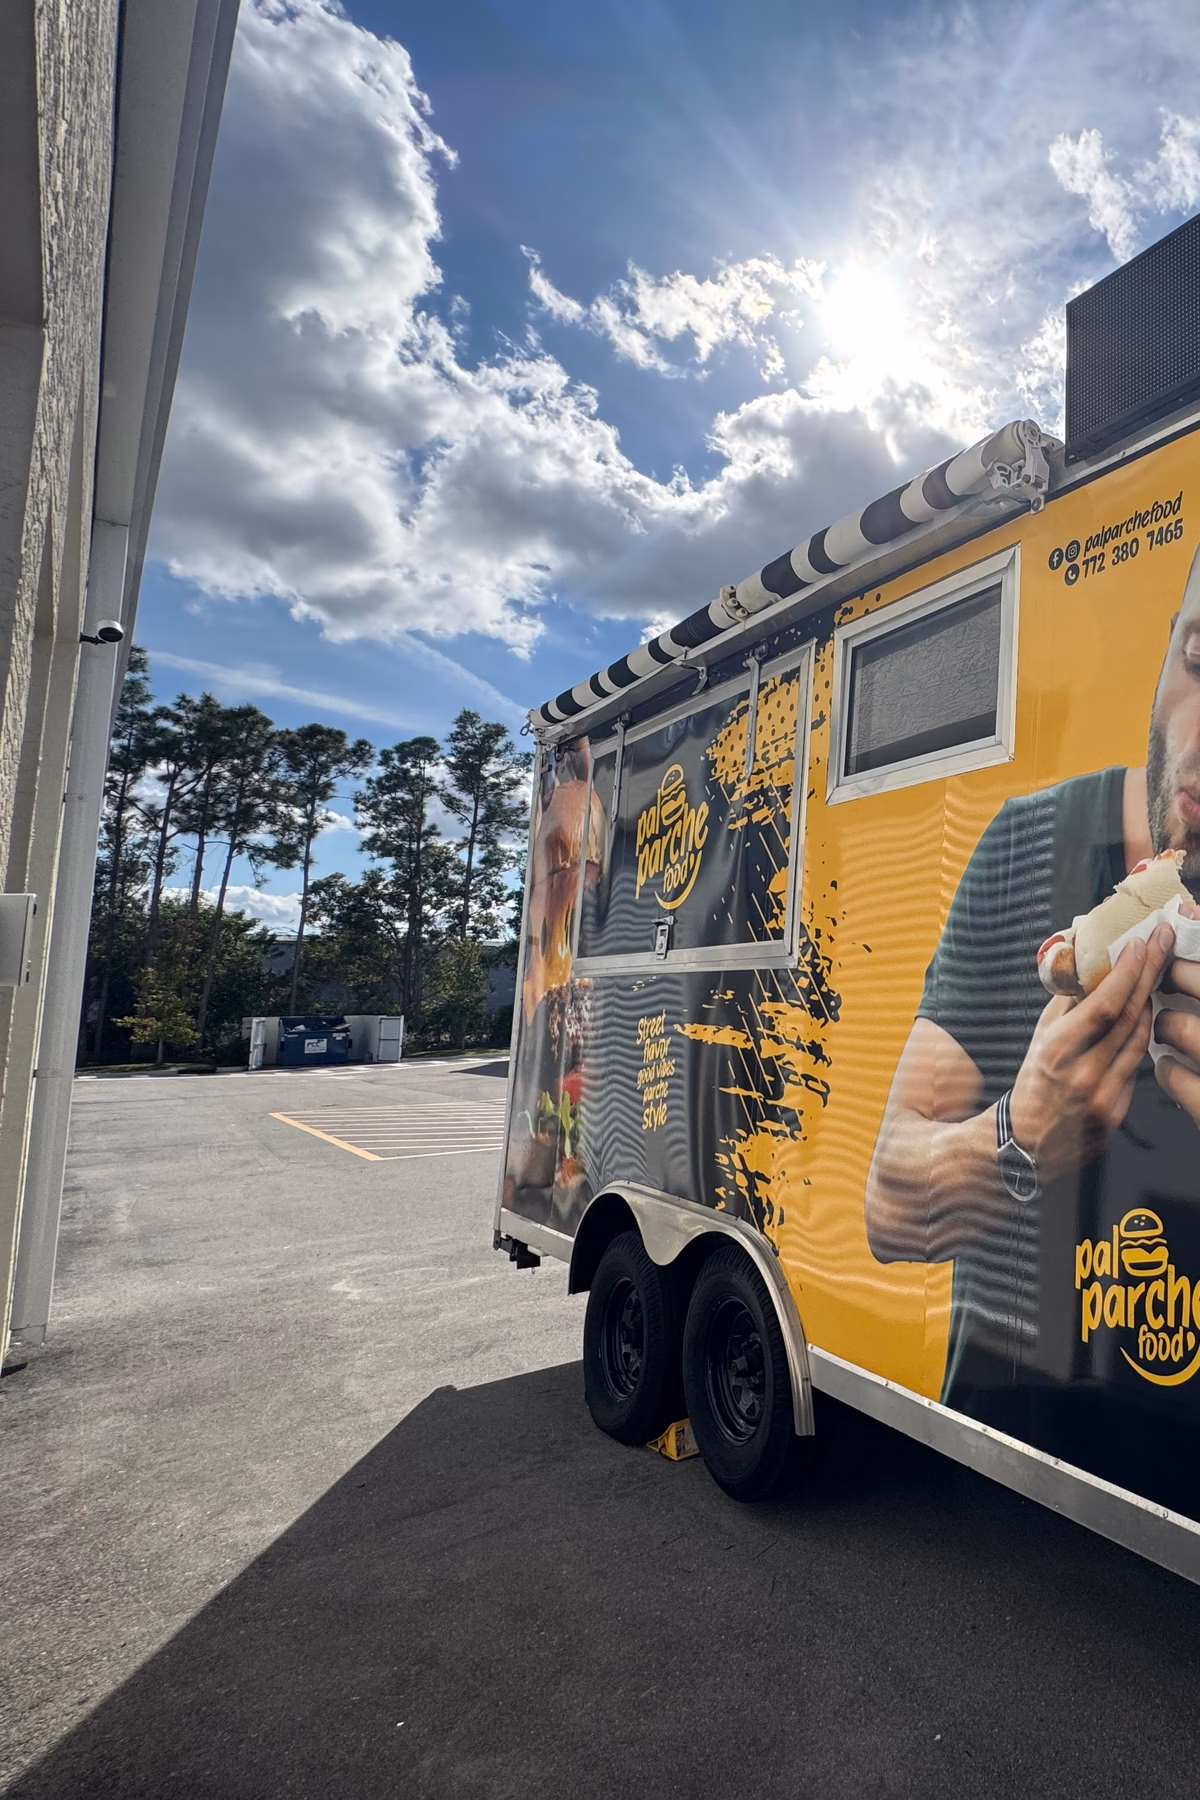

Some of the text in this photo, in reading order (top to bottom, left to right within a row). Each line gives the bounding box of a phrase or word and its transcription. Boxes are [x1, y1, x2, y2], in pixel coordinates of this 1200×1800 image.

[1083, 490, 1184, 557] palparchefood
[1082, 517, 1184, 578] 772 380 7465
[635, 788, 661, 857] pal
[635, 801, 710, 900] parche
[663, 851, 689, 894] food
[643, 1036, 672, 1063] flavor
[637, 1058, 676, 1090] good vibes
[643, 1079, 669, 1107] parche
[642, 1098, 668, 1132] style
[1075, 1224, 1119, 1290] pal
[1138, 1323, 1184, 1363] food
